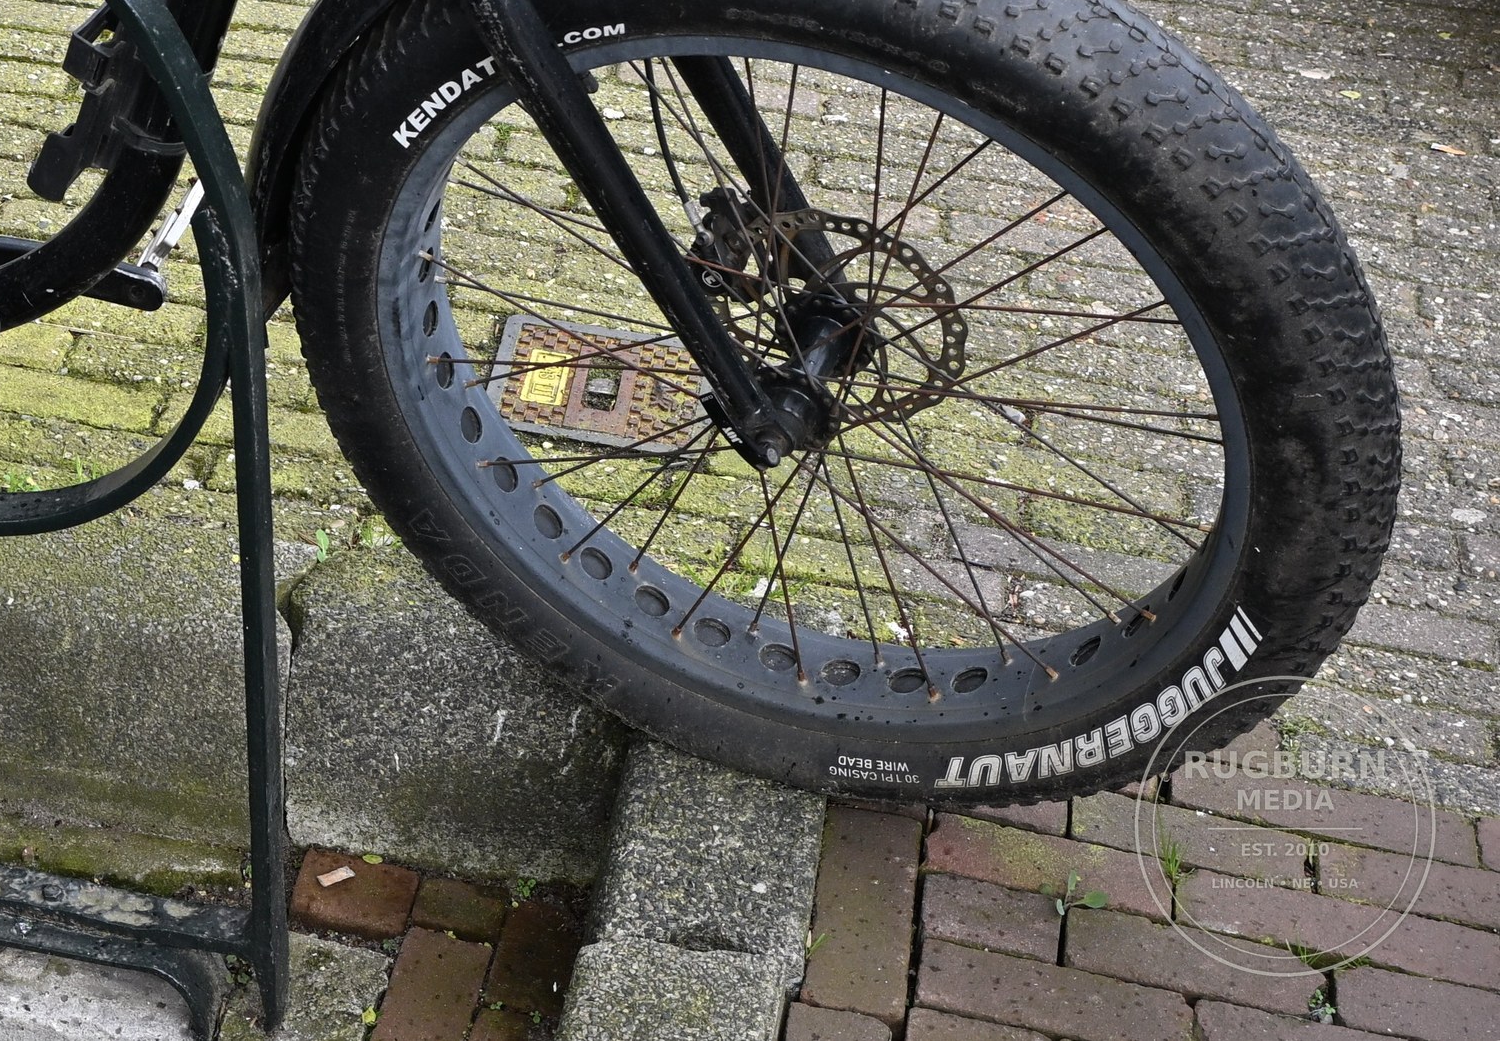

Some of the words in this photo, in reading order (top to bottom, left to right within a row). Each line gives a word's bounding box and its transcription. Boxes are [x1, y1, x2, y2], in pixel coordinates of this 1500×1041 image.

[934, 645, 1230, 789] JUGGERNAUT
[838, 755, 873, 770] BEAD
[875, 760, 909, 772] WIRE
[828, 765, 878, 781] CASING
[904, 774, 920, 784] 30
